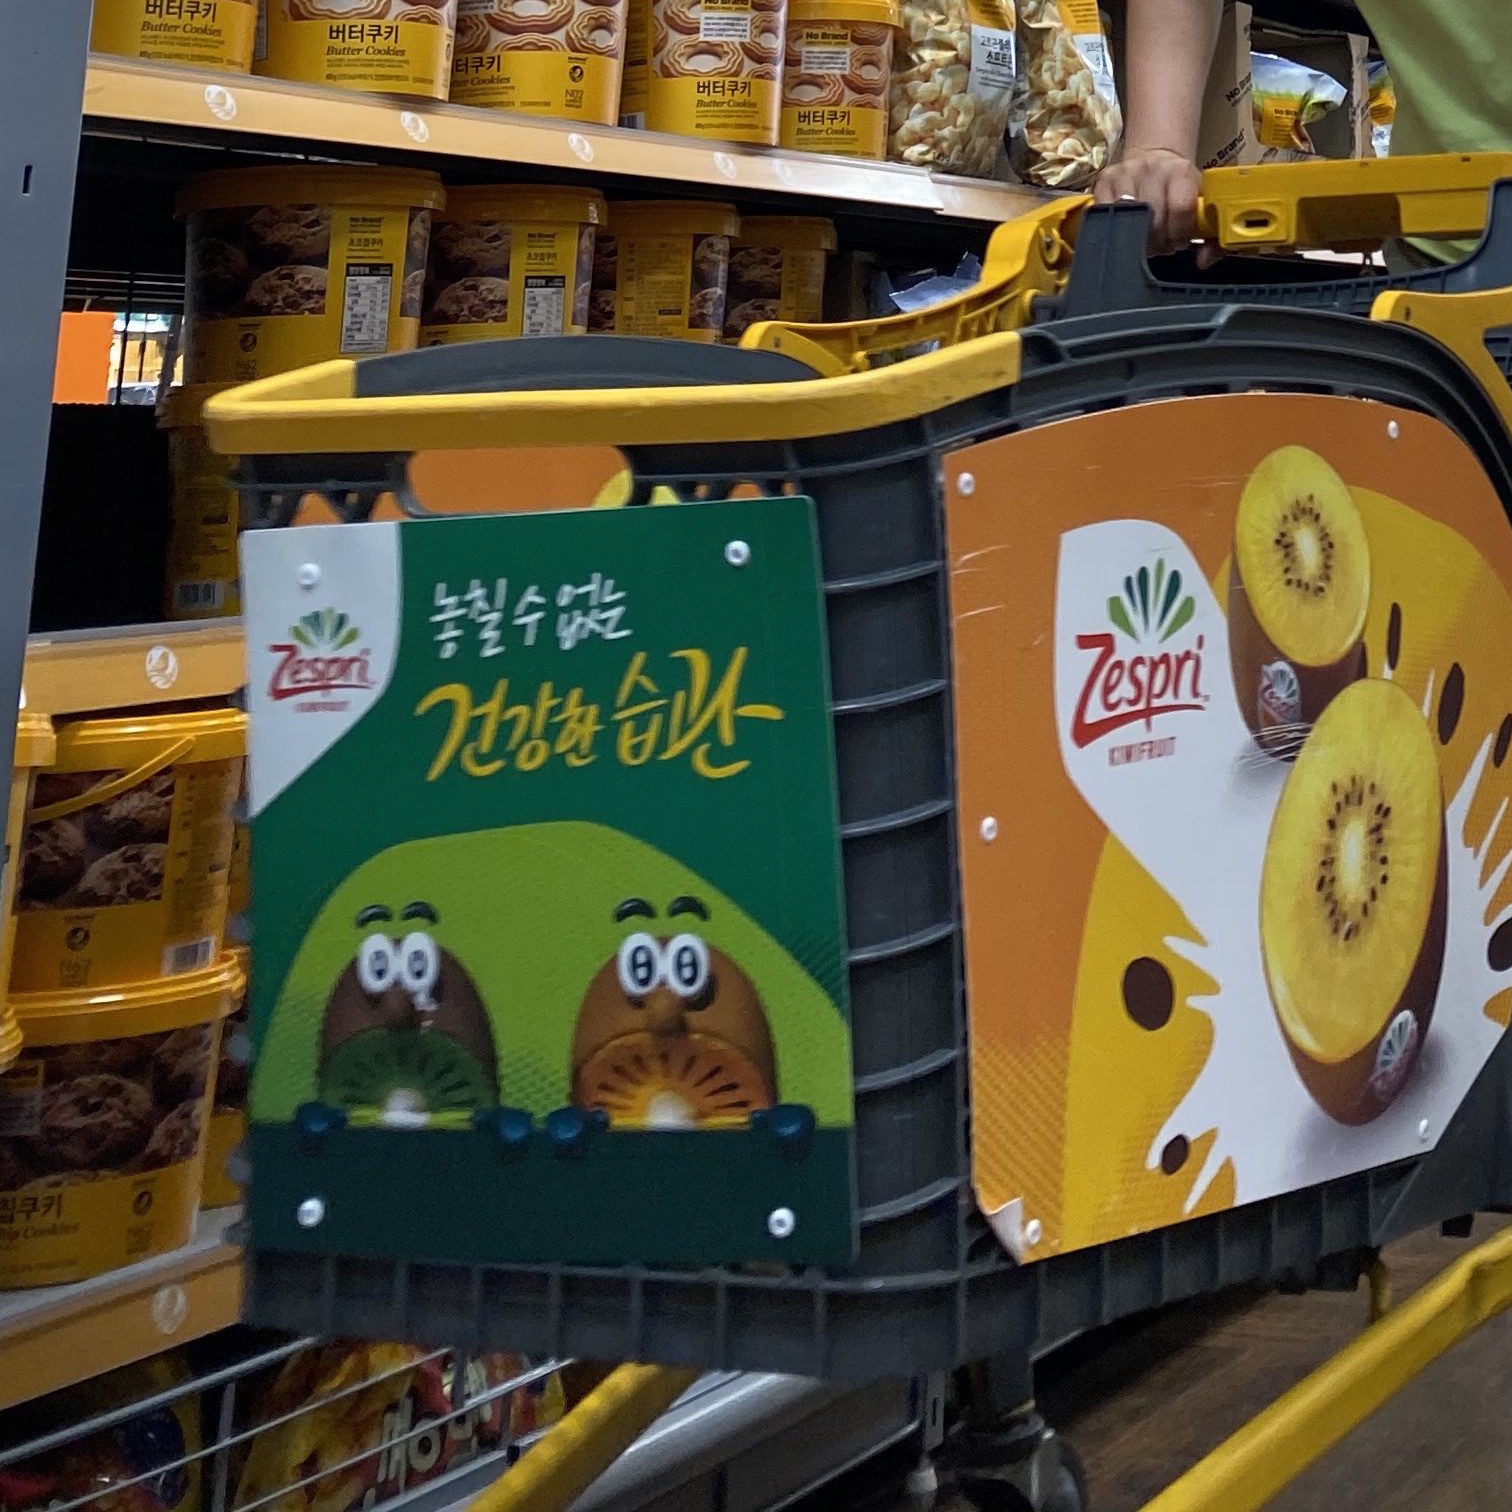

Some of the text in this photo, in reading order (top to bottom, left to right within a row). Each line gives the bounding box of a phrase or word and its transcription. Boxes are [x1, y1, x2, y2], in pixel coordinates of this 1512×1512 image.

[140, 21, 222, 37] Butter Cookies
[328, 23, 400, 44] 버터쿠키
[805, 31, 849, 43] No Brand
[325, 45, 406, 58] Butter Cookies
[696, 80, 752, 98] 버터쿠키
[695, 98, 724, 109] Butter
[797, 110, 852, 127] 버터쿠키
[1216, 133, 1245, 161] Brand
[429, 572, 634, 660] 놓칠 수 없는
[268, 643, 376, 702] Zespri
[1071, 632, 1206, 750] Zespri
[414, 646, 786, 783] 건강한 습관
[0, 1192, 63, 1224] 칩쿠키
